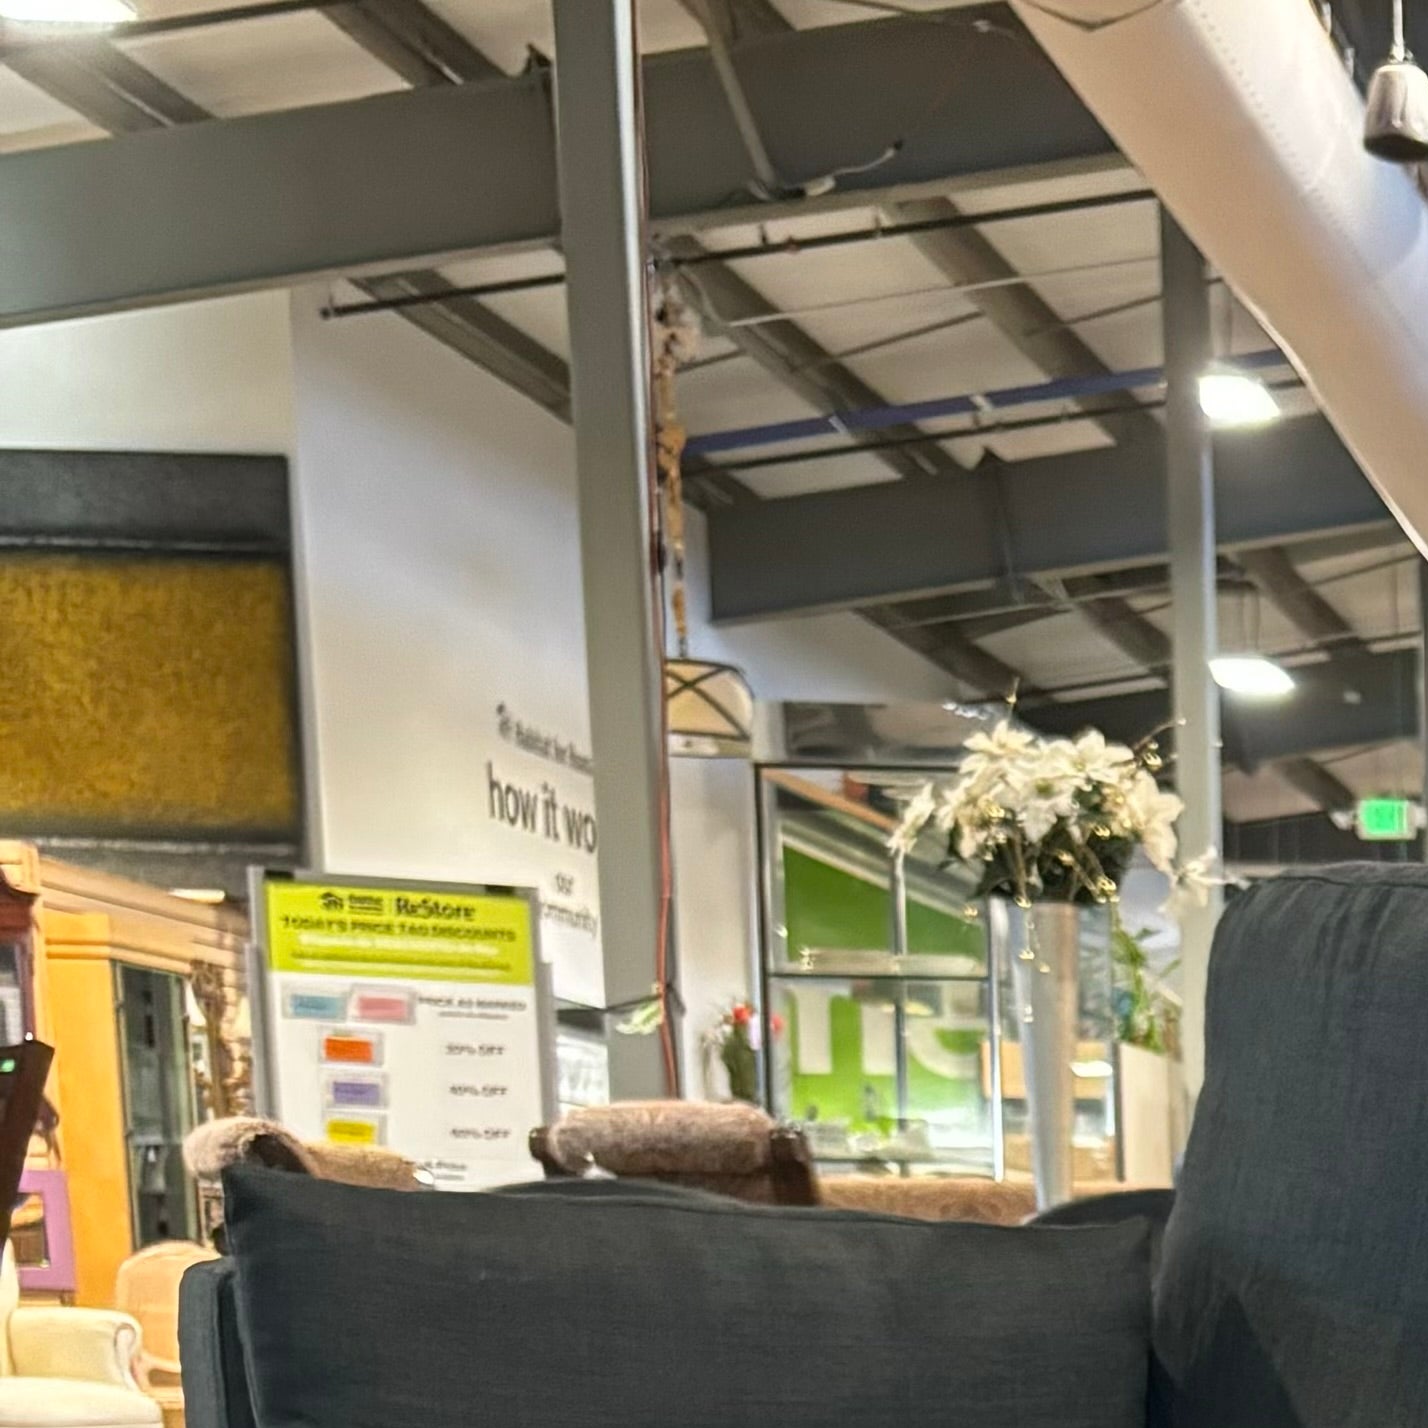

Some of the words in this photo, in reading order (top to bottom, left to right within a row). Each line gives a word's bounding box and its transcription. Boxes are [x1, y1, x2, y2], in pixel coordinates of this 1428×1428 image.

[486, 760, 537, 834] how
[541, 780, 560, 842] it
[563, 804, 597, 854] wo
[396, 895, 476, 922] ReStore
